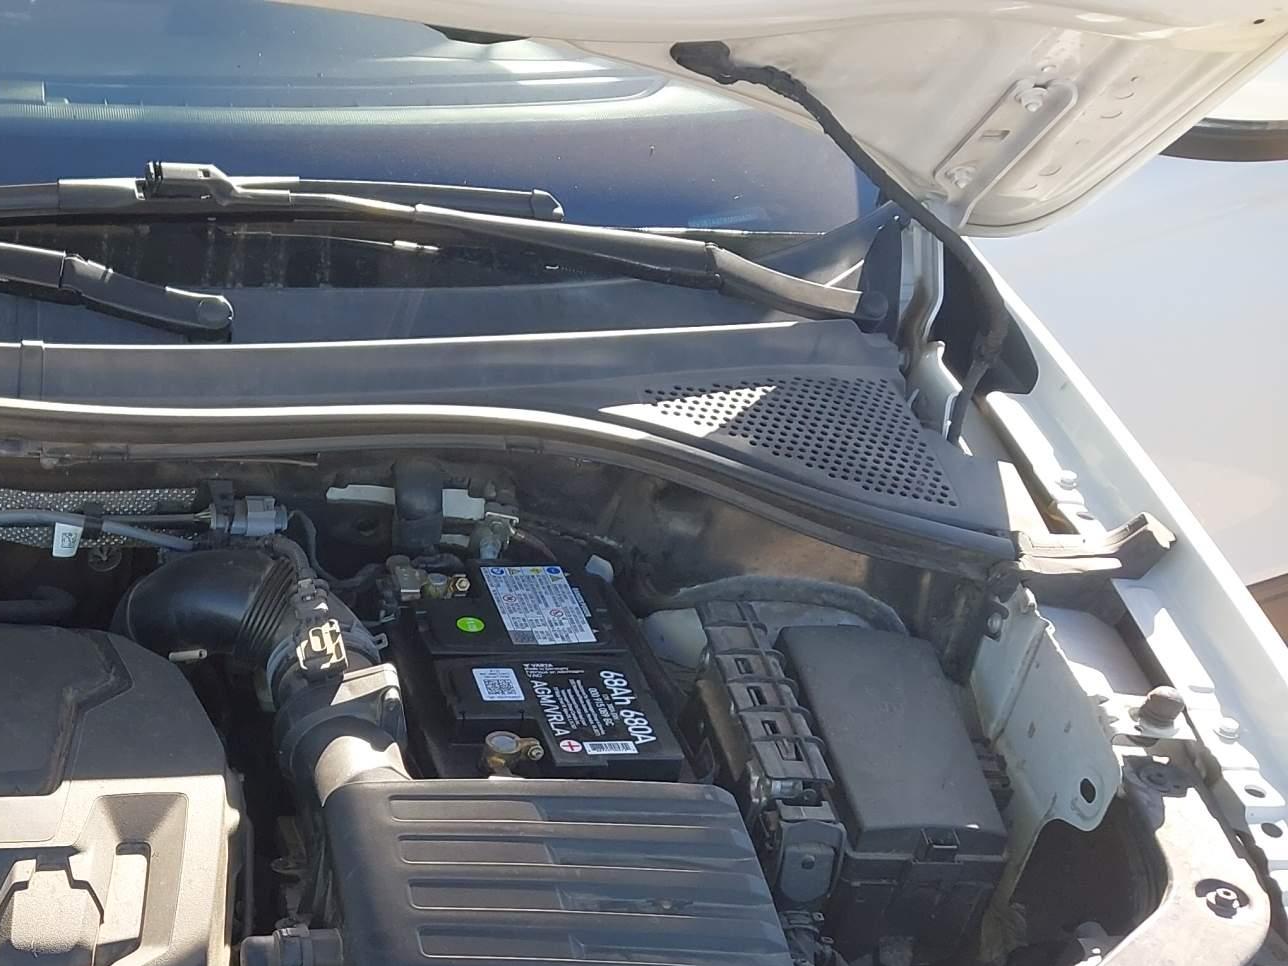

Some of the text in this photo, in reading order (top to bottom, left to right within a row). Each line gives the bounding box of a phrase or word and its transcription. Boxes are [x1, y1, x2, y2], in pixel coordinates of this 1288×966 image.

[530, 680, 571, 736] AGM/VRLA
[600, 670, 637, 706] 68Ah
[619, 709, 657, 745] 680A
